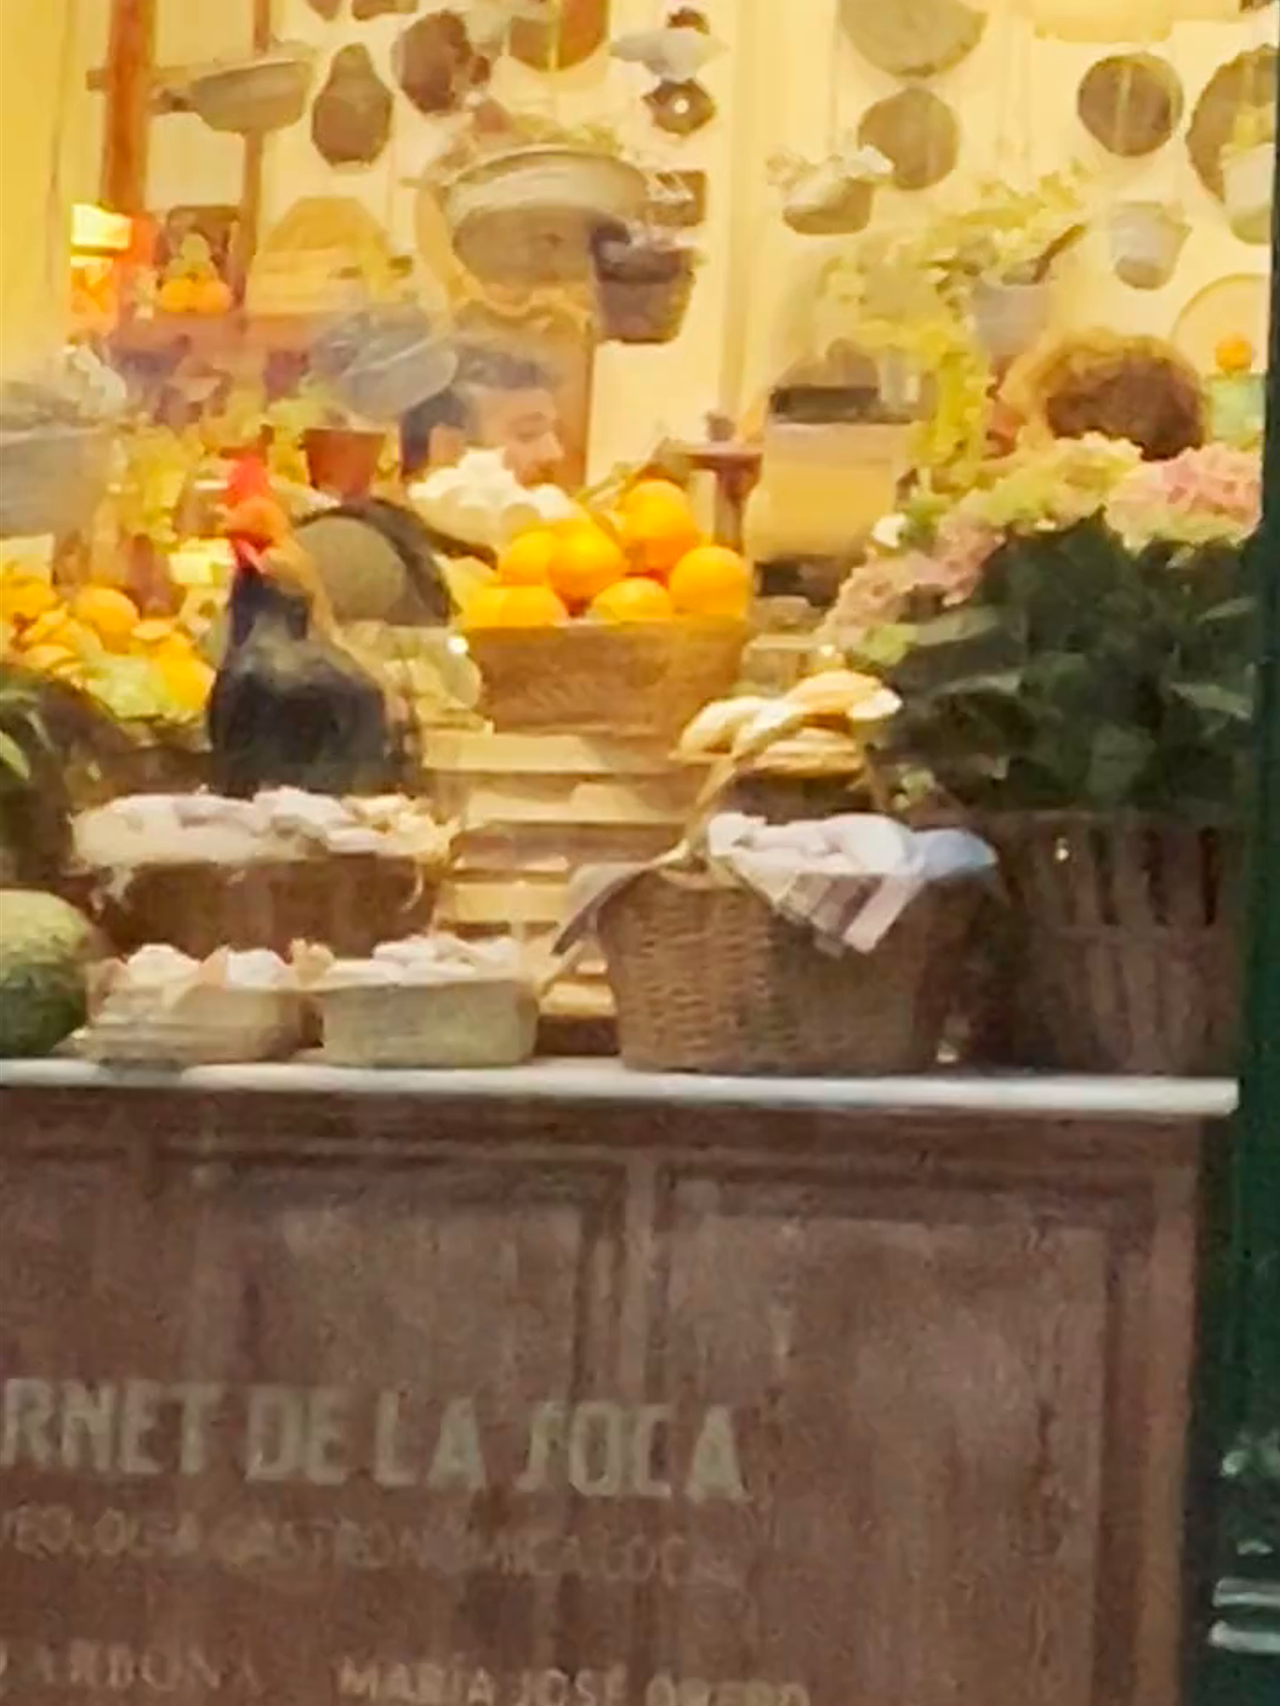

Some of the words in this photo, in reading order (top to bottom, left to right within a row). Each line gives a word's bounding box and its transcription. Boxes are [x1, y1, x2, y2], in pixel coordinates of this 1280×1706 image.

[244, 1386, 350, 1486] DE
[373, 1389, 488, 1493] LA
[515, 1398, 752, 1504] SOCA
